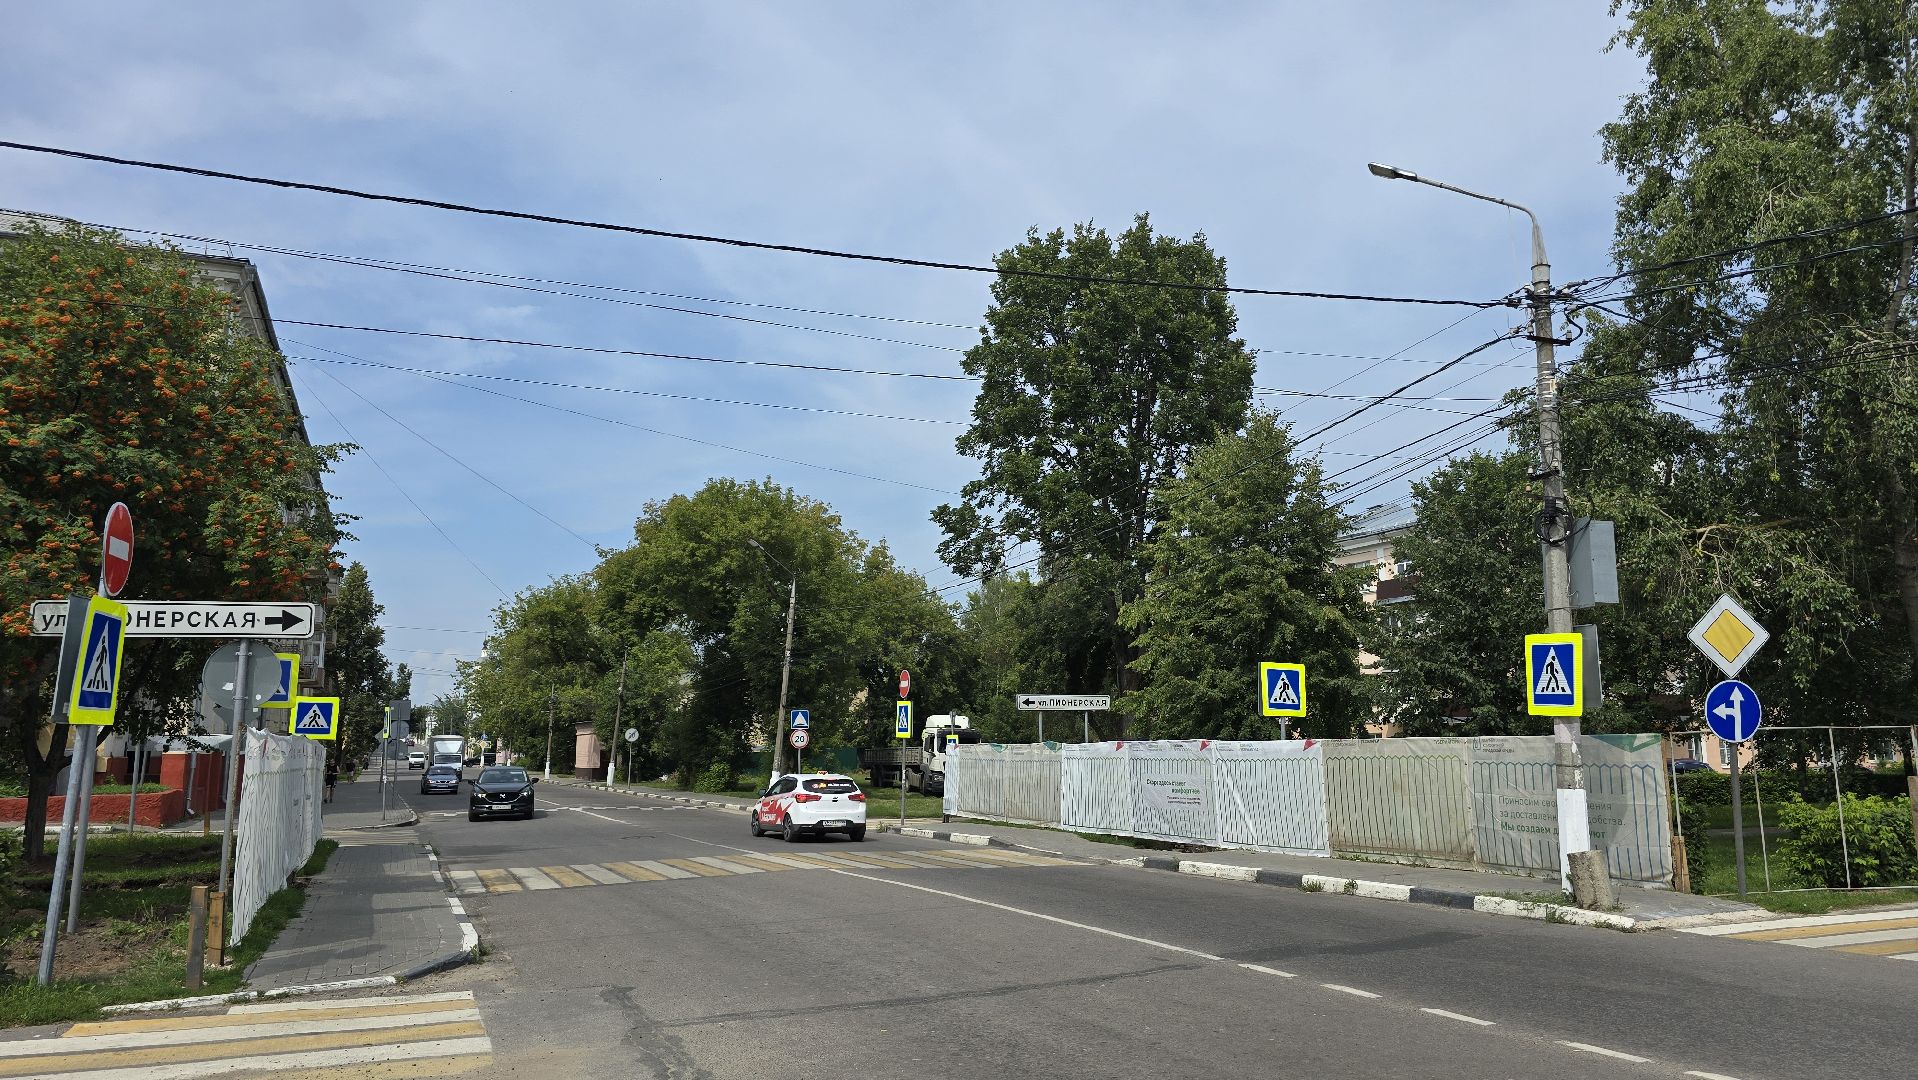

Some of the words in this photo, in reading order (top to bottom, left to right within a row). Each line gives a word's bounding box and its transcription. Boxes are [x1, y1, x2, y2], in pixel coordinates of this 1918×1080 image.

[41, 614, 67, 631] ул
[126, 610, 256, 628] НЕРСКАЯ
[1049, 698, 1107, 707] ПИОНЕРСКАЯ
[1498, 795, 1540, 807] Приносим
[1499, 810, 1509, 818] за
[1510, 811, 1558, 822] доставленн
[1500, 821, 1514, 832] Мы
[1516, 824, 1551, 835] создаем
